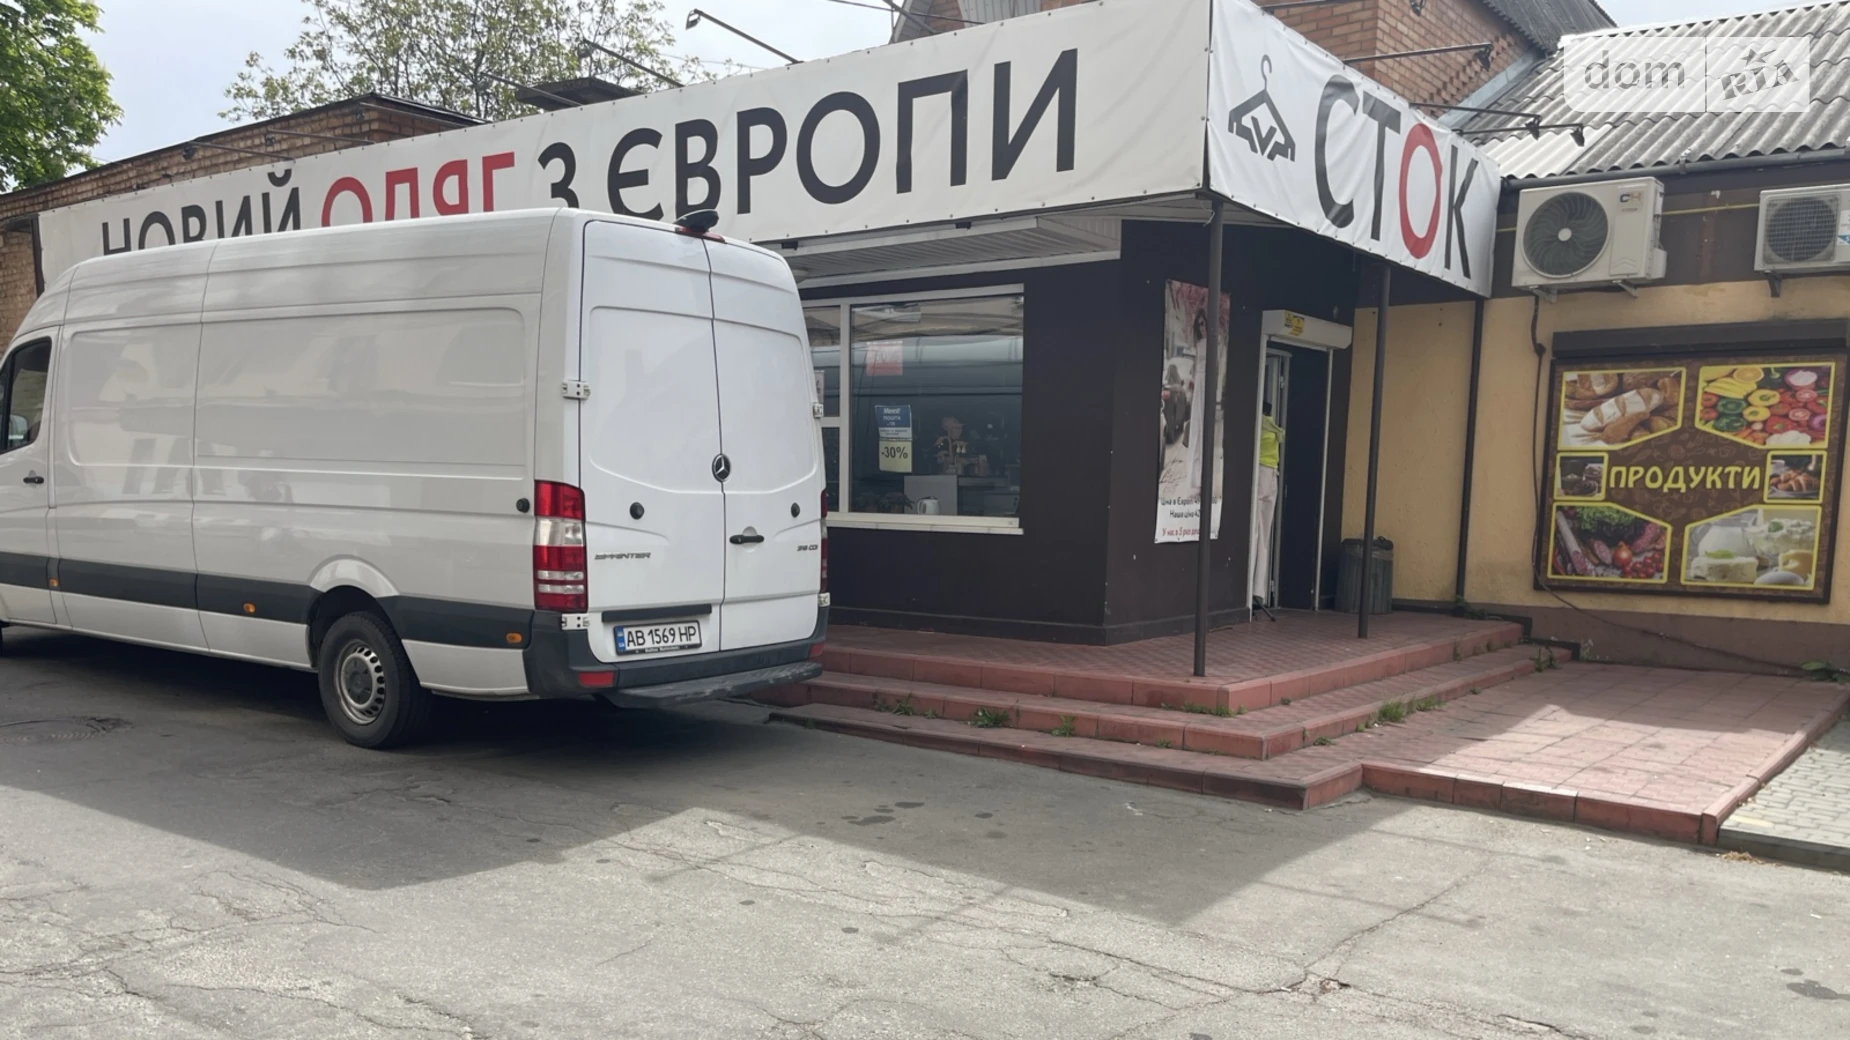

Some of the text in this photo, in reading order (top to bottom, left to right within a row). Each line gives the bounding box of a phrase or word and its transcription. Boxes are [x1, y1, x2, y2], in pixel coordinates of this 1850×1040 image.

[607, 48, 1078, 221] ЄВРОПИ
[1315, 75, 1479, 279] СТОК
[881, 446, 908, 459] -30%
[1609, 466, 1761, 493] ПРОДУКТИ
[627, 625, 697, 647] AB 1569 HP
